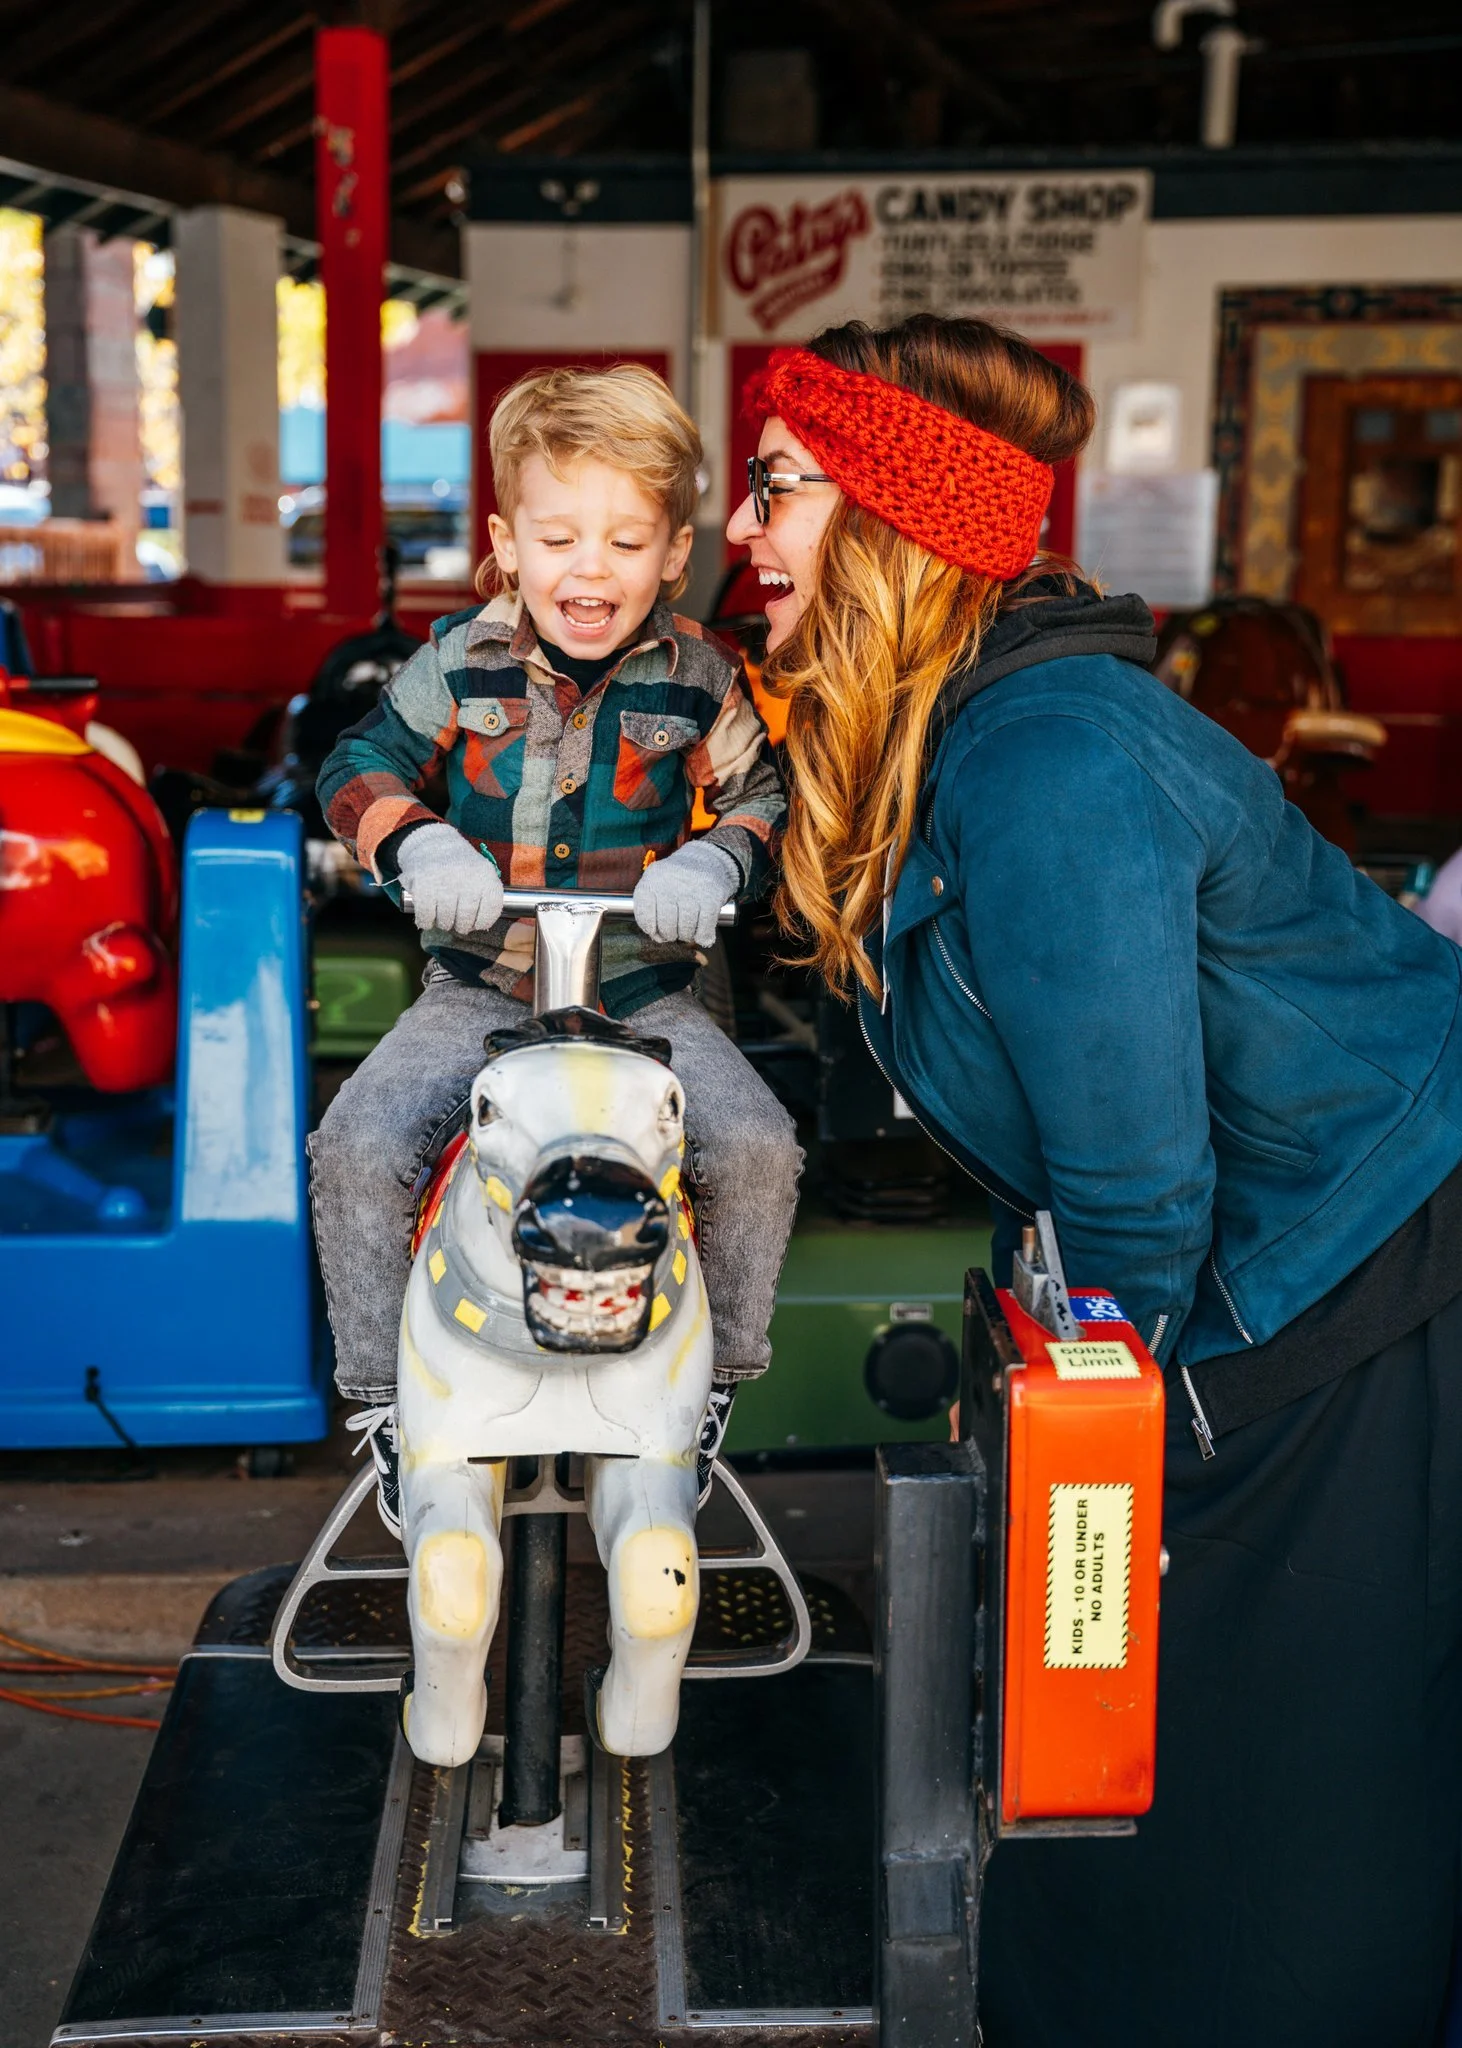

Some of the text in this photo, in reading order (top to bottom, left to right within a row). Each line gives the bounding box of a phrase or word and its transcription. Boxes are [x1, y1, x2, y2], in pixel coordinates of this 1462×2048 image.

[875, 182, 1138, 226] CANDY SHOP
[1060, 1346, 1119, 1356] 60lbs
[1068, 1357, 1124, 1368] Limit
[1076, 1499, 1089, 1553] UNDER
[1075, 1558, 1086, 1580] OR
[1091, 1532, 1105, 1622] NO ADULTS
[1074, 1586, 1085, 1601] 10
[1072, 1619, 1084, 1655] KIDS
